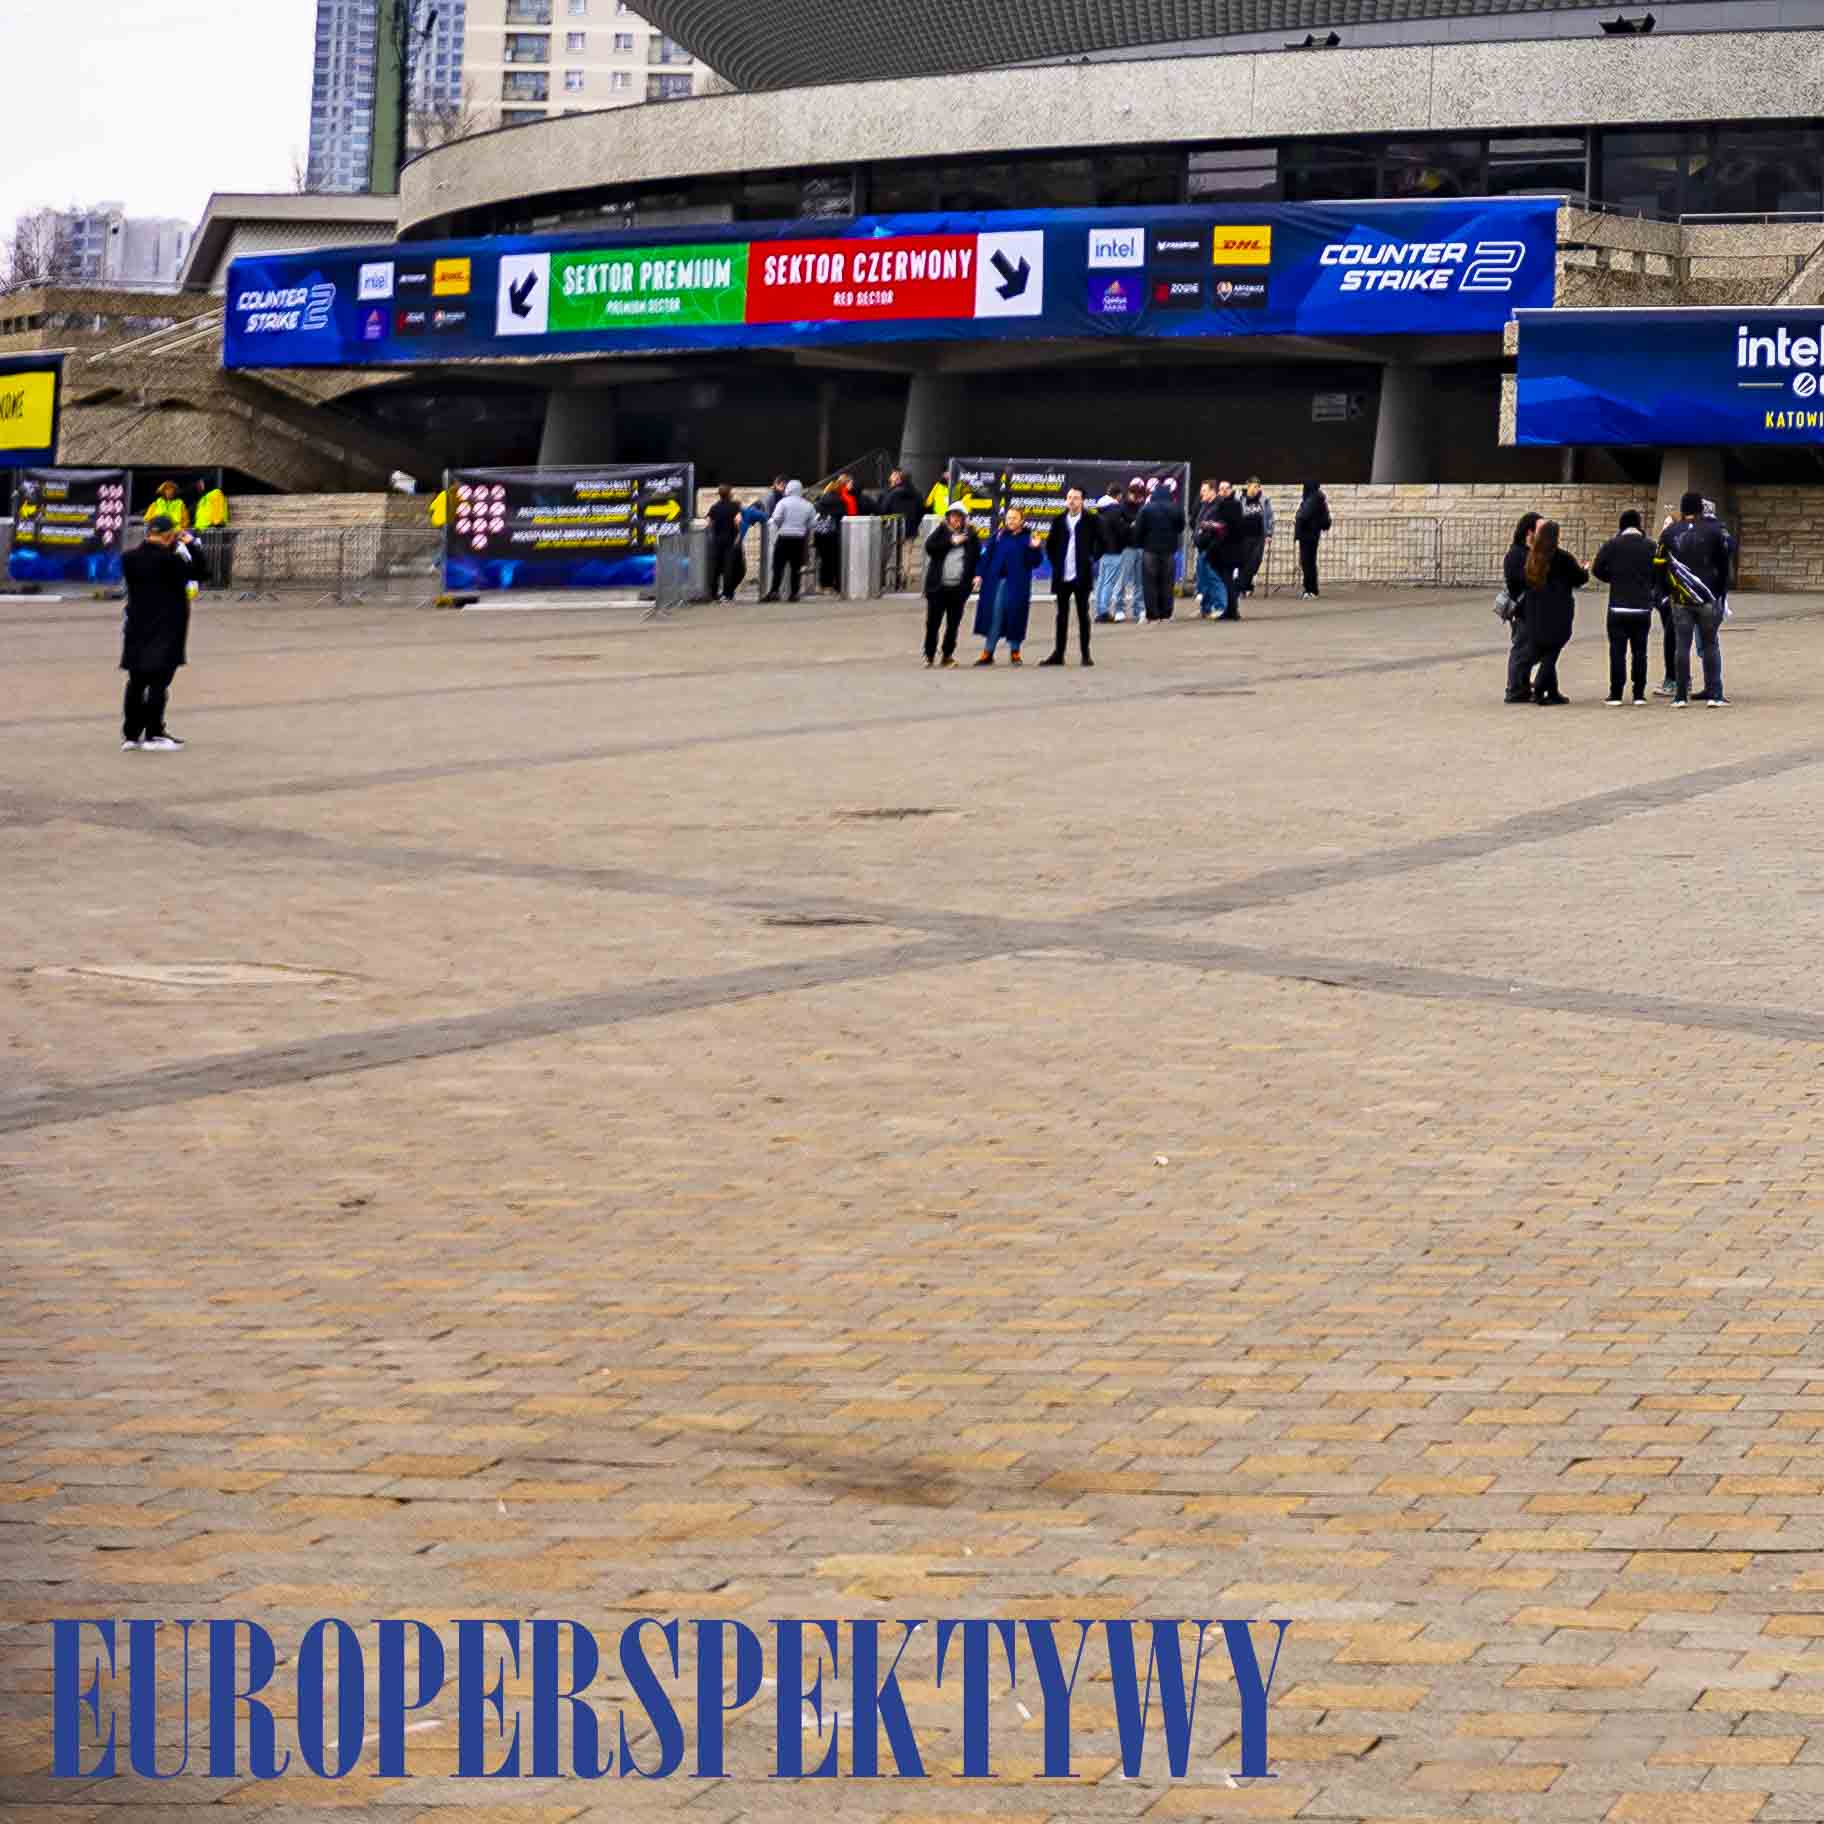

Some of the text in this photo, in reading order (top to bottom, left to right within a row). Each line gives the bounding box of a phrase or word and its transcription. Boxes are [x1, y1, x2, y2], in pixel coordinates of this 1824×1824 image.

[1094, 235, 1137, 259] intel
[1319, 241, 1469, 266] COUNTER
[562, 256, 732, 297] SEKTOR PREMIUM
[763, 247, 974, 287] SEKTOR CZERWONY
[1457, 240, 1526, 293] 2
[1338, 268, 1455, 292] STRIKE
[236, 287, 309, 312] COUNTER
[832, 289, 894, 307] RED SECTOR
[243, 310, 301, 335] STRIKE
